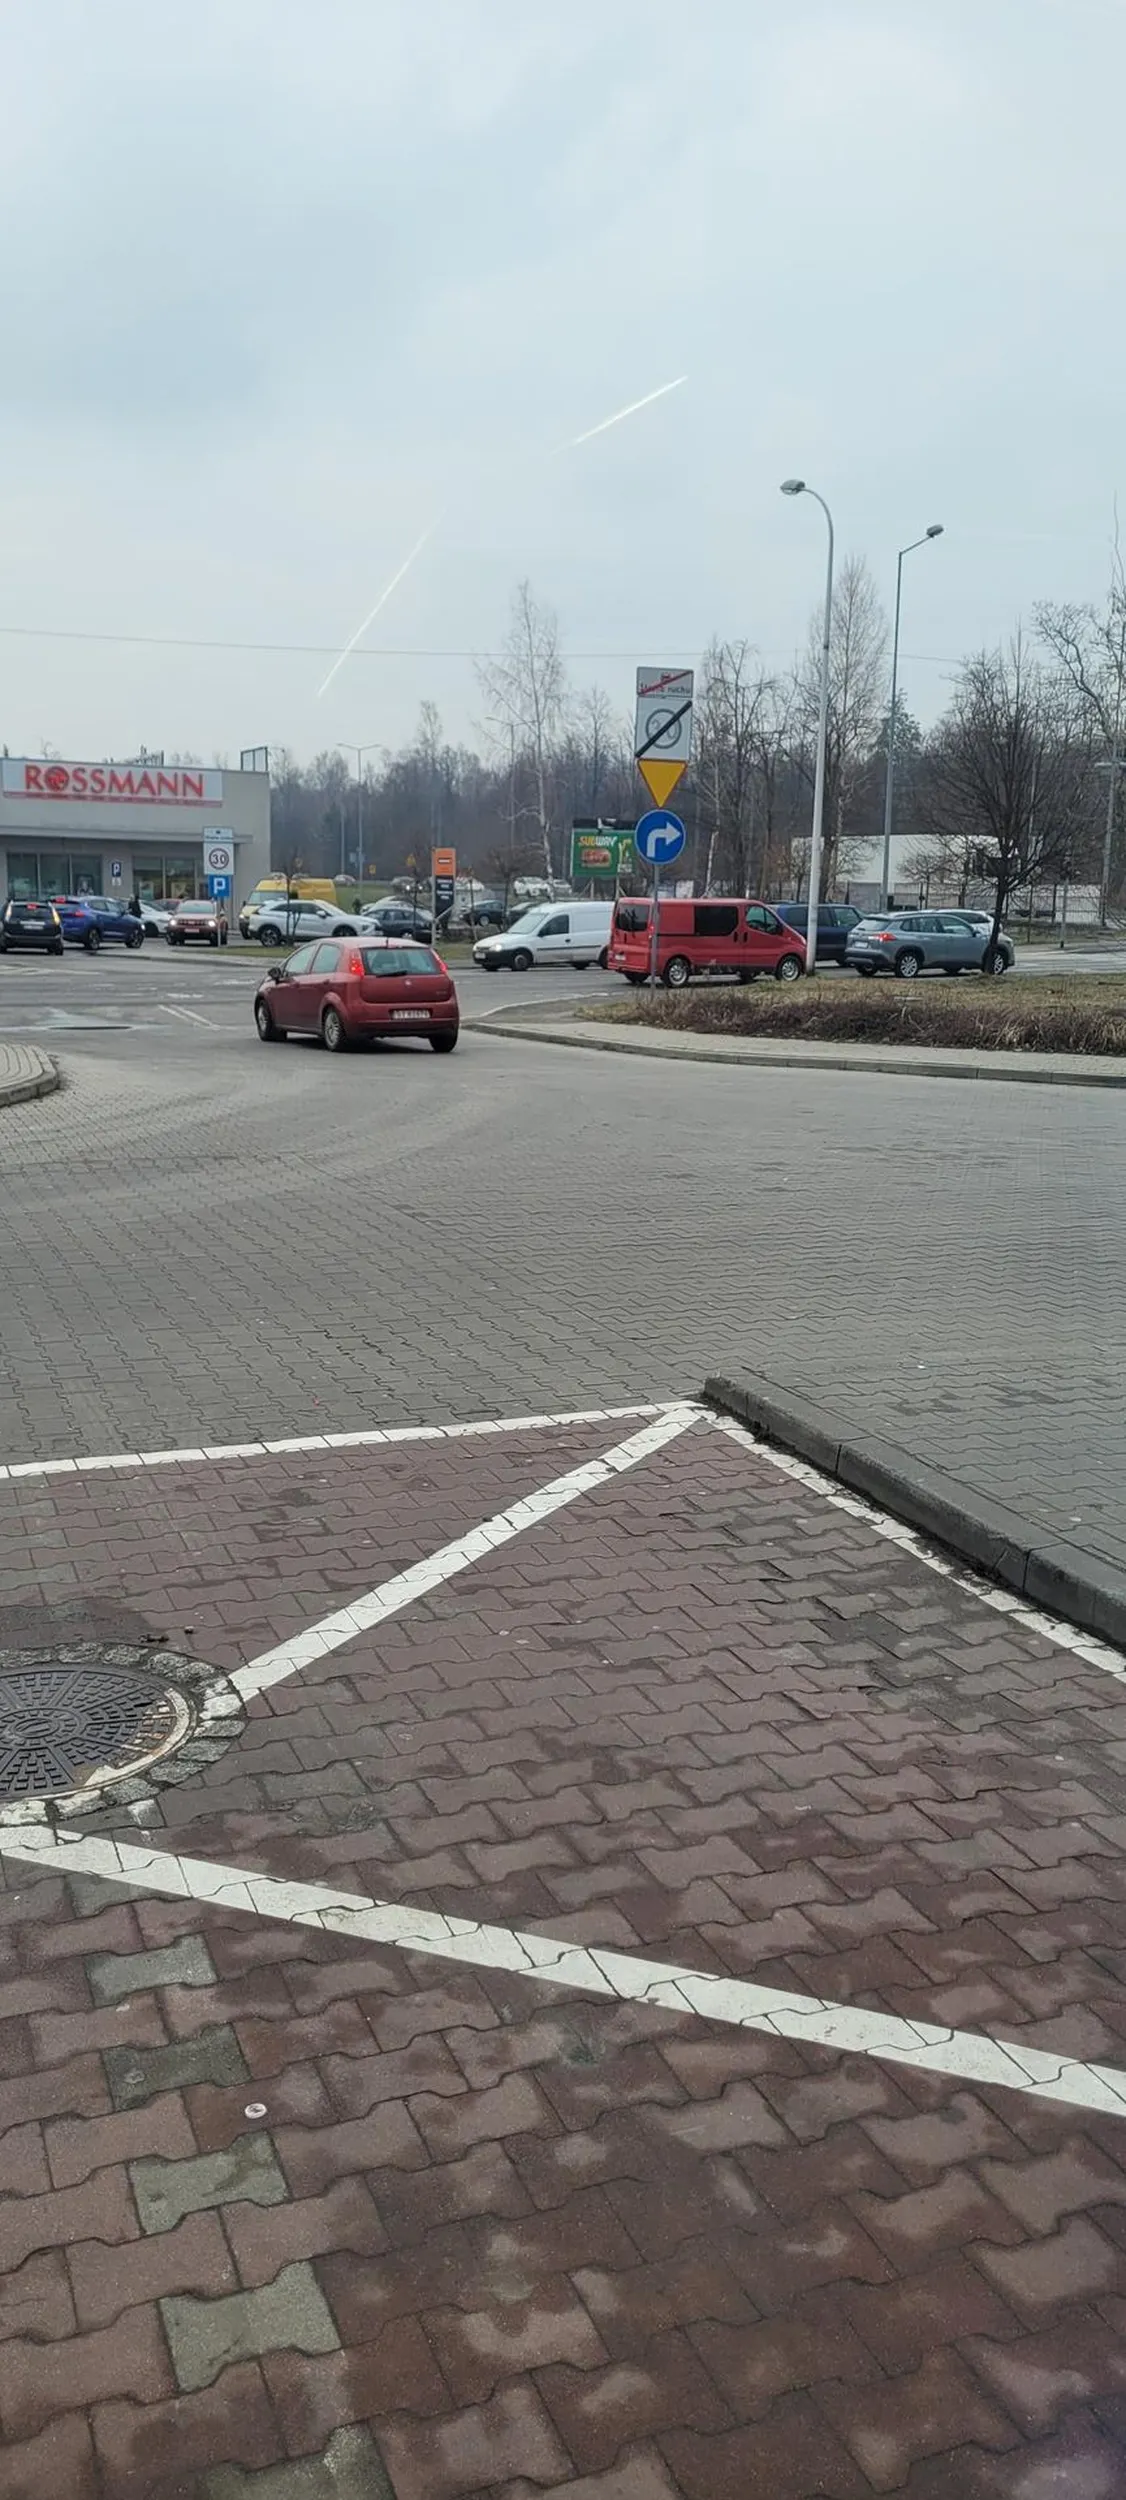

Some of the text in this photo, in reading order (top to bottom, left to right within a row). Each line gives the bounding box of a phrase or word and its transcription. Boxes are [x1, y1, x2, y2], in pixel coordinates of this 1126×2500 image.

[25, 764, 204, 798] ROSSMANN
[578, 836, 618, 847] SUBWAY
[212, 853, 227, 865] 30
[213, 877, 226, 894] P
